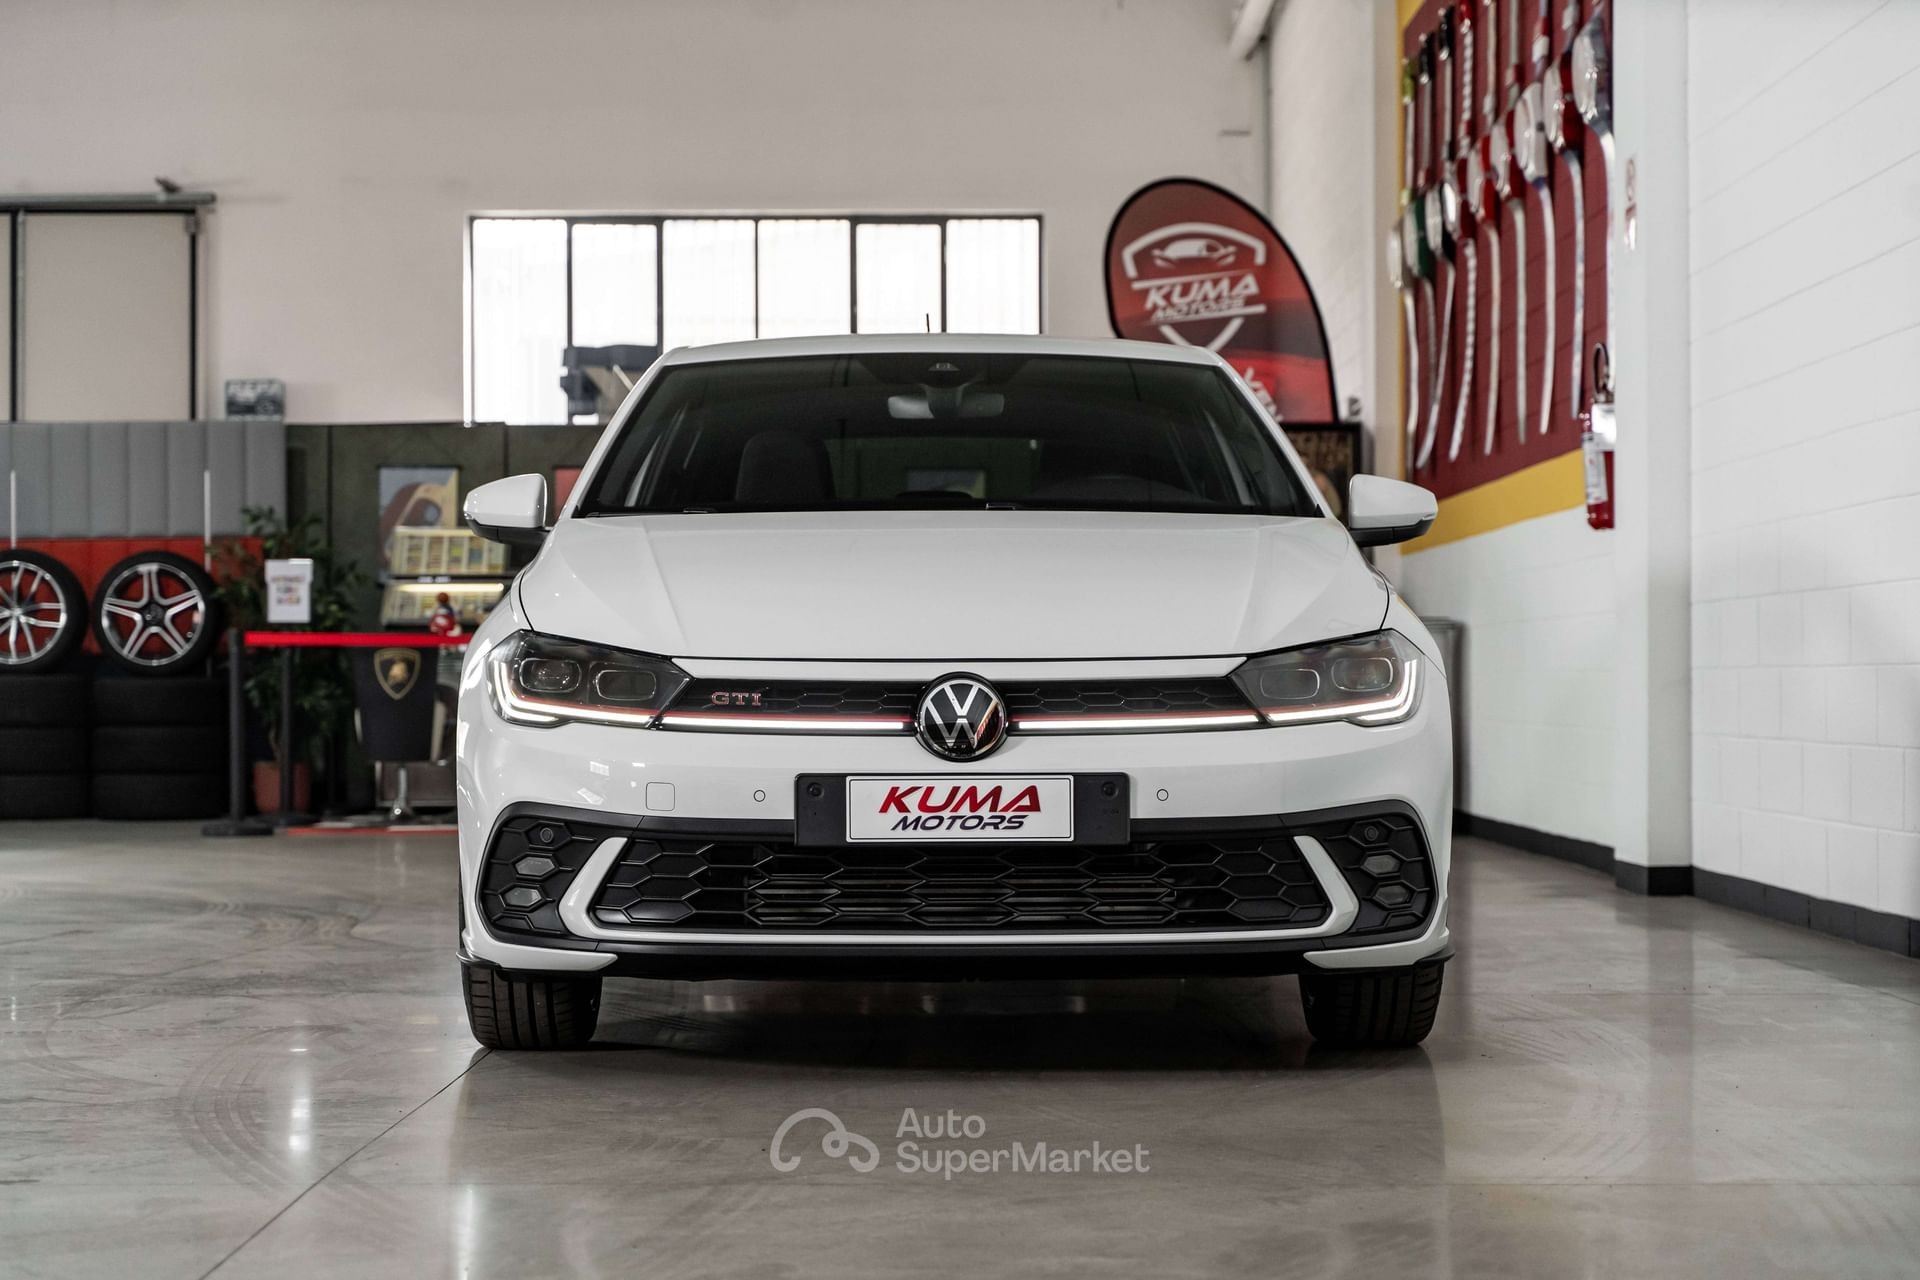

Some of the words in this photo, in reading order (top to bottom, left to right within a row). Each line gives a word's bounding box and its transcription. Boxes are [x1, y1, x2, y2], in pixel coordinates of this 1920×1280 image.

[1144, 273, 1260, 310] KUMA
[1152, 296, 1246, 322] MOTORS
[711, 691, 762, 707] GTI
[878, 785, 1041, 814] KUMA
[891, 814, 1029, 831] MOTORS
